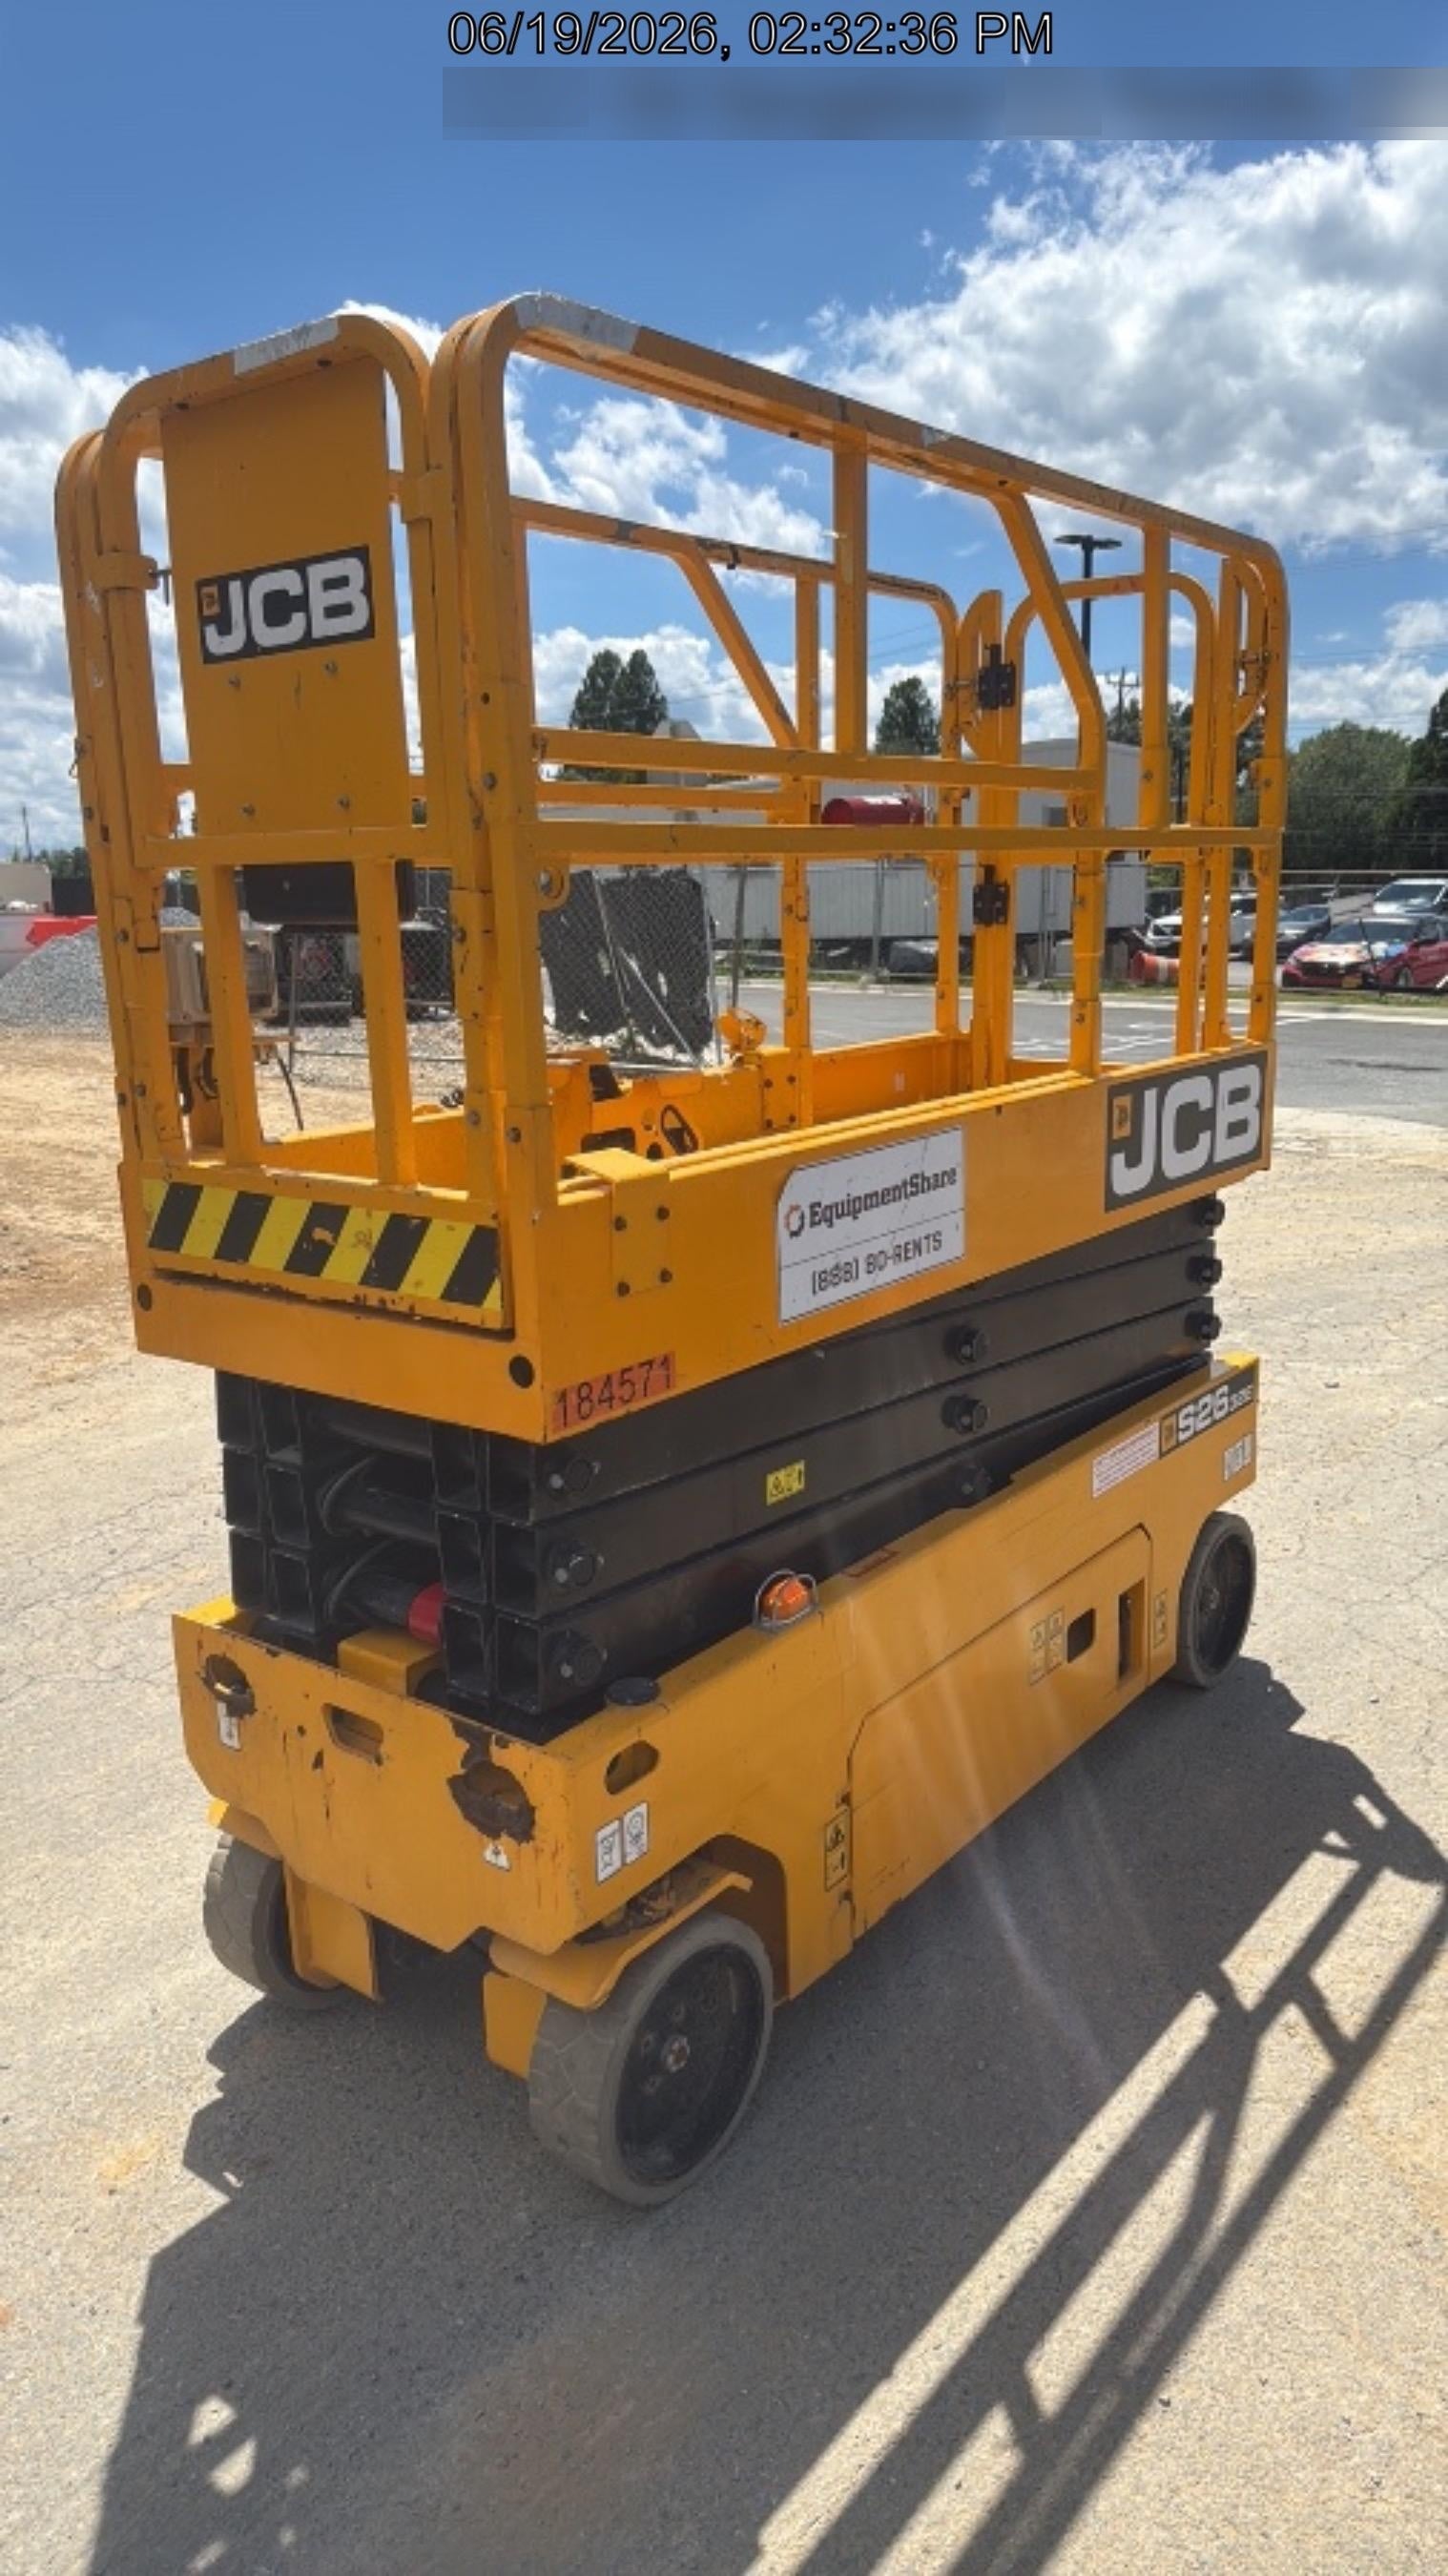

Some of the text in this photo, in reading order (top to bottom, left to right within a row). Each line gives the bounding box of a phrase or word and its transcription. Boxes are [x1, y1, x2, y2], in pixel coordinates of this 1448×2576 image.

[203, 556, 370, 656] JCB
[1111, 1064, 1262, 1196] JCB
[808, 1167, 958, 1229] EquipmentShare
[557, 1353, 671, 1428] 184571
